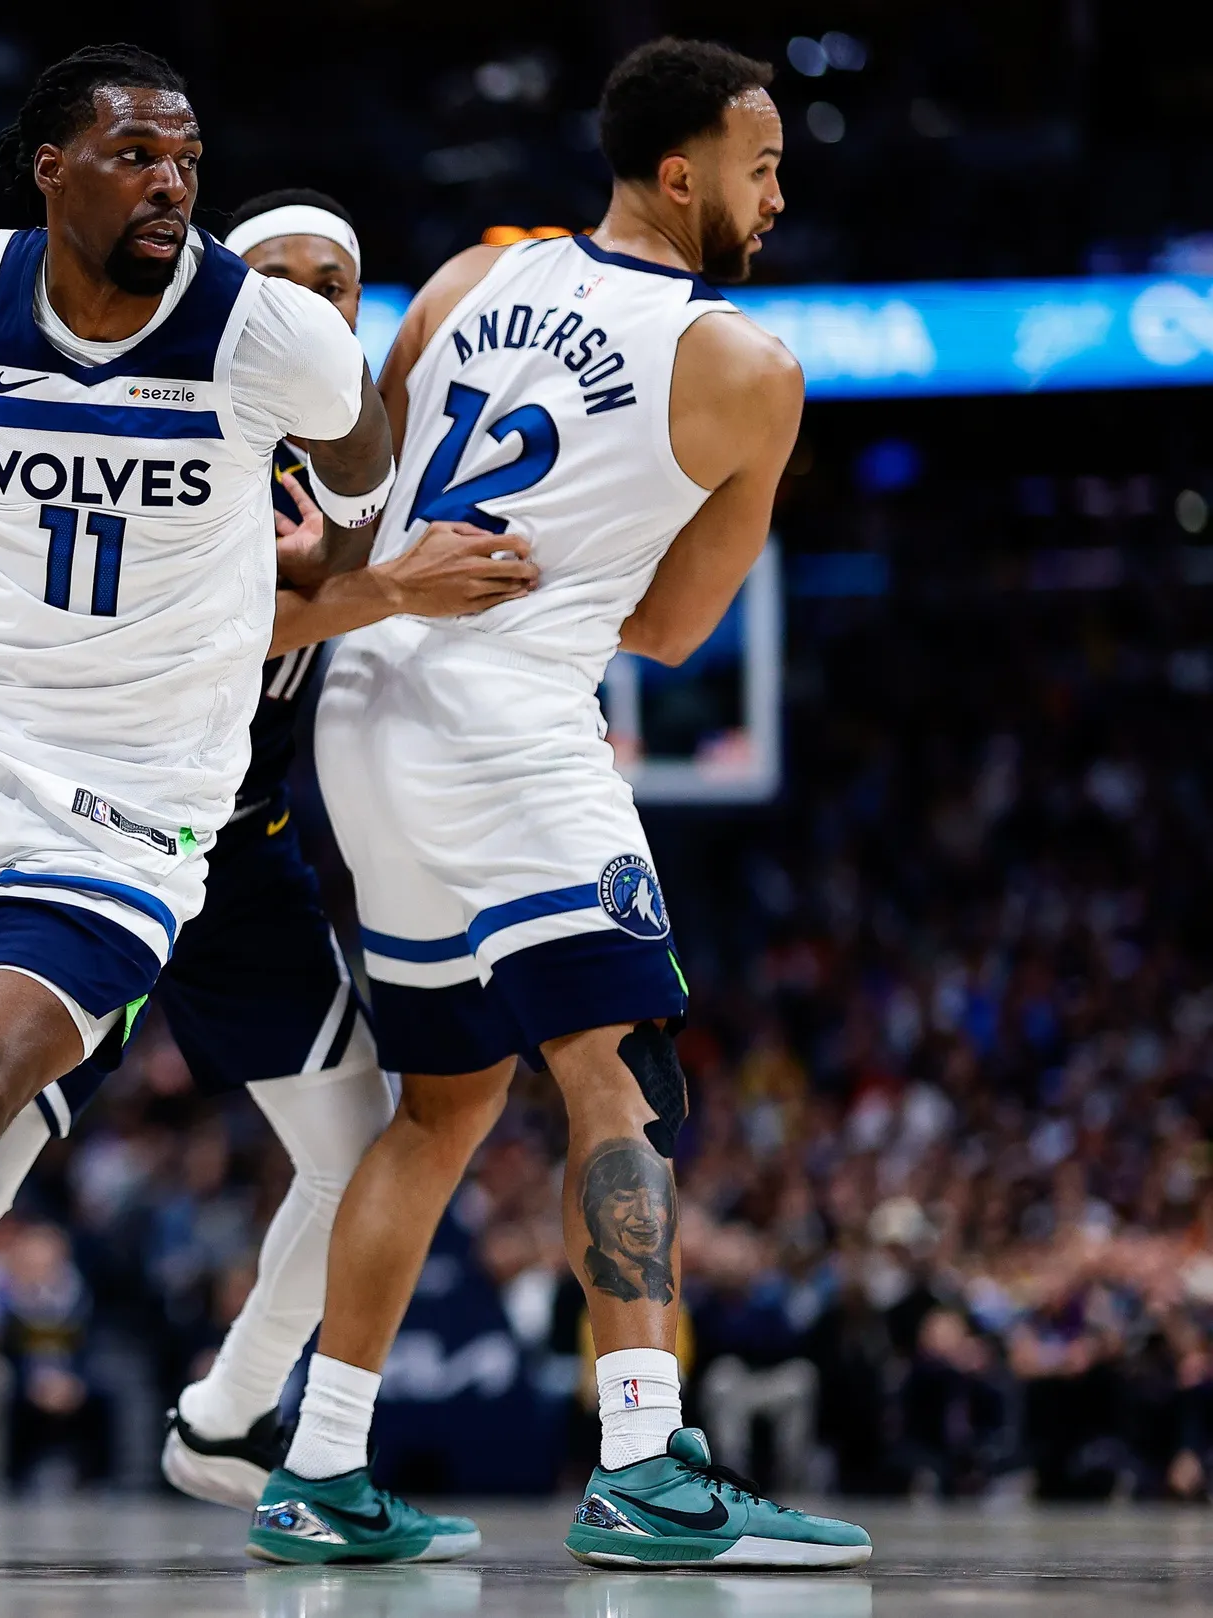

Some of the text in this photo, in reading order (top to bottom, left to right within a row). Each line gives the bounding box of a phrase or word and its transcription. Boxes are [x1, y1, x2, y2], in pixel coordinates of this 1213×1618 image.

[141, 386, 195, 403] sezzle
[451, 304, 638, 416] ANDERSON
[403, 380, 560, 535] 12
[38, 503, 127, 618] 11
[601, 856, 628, 913] MINNESOTA
